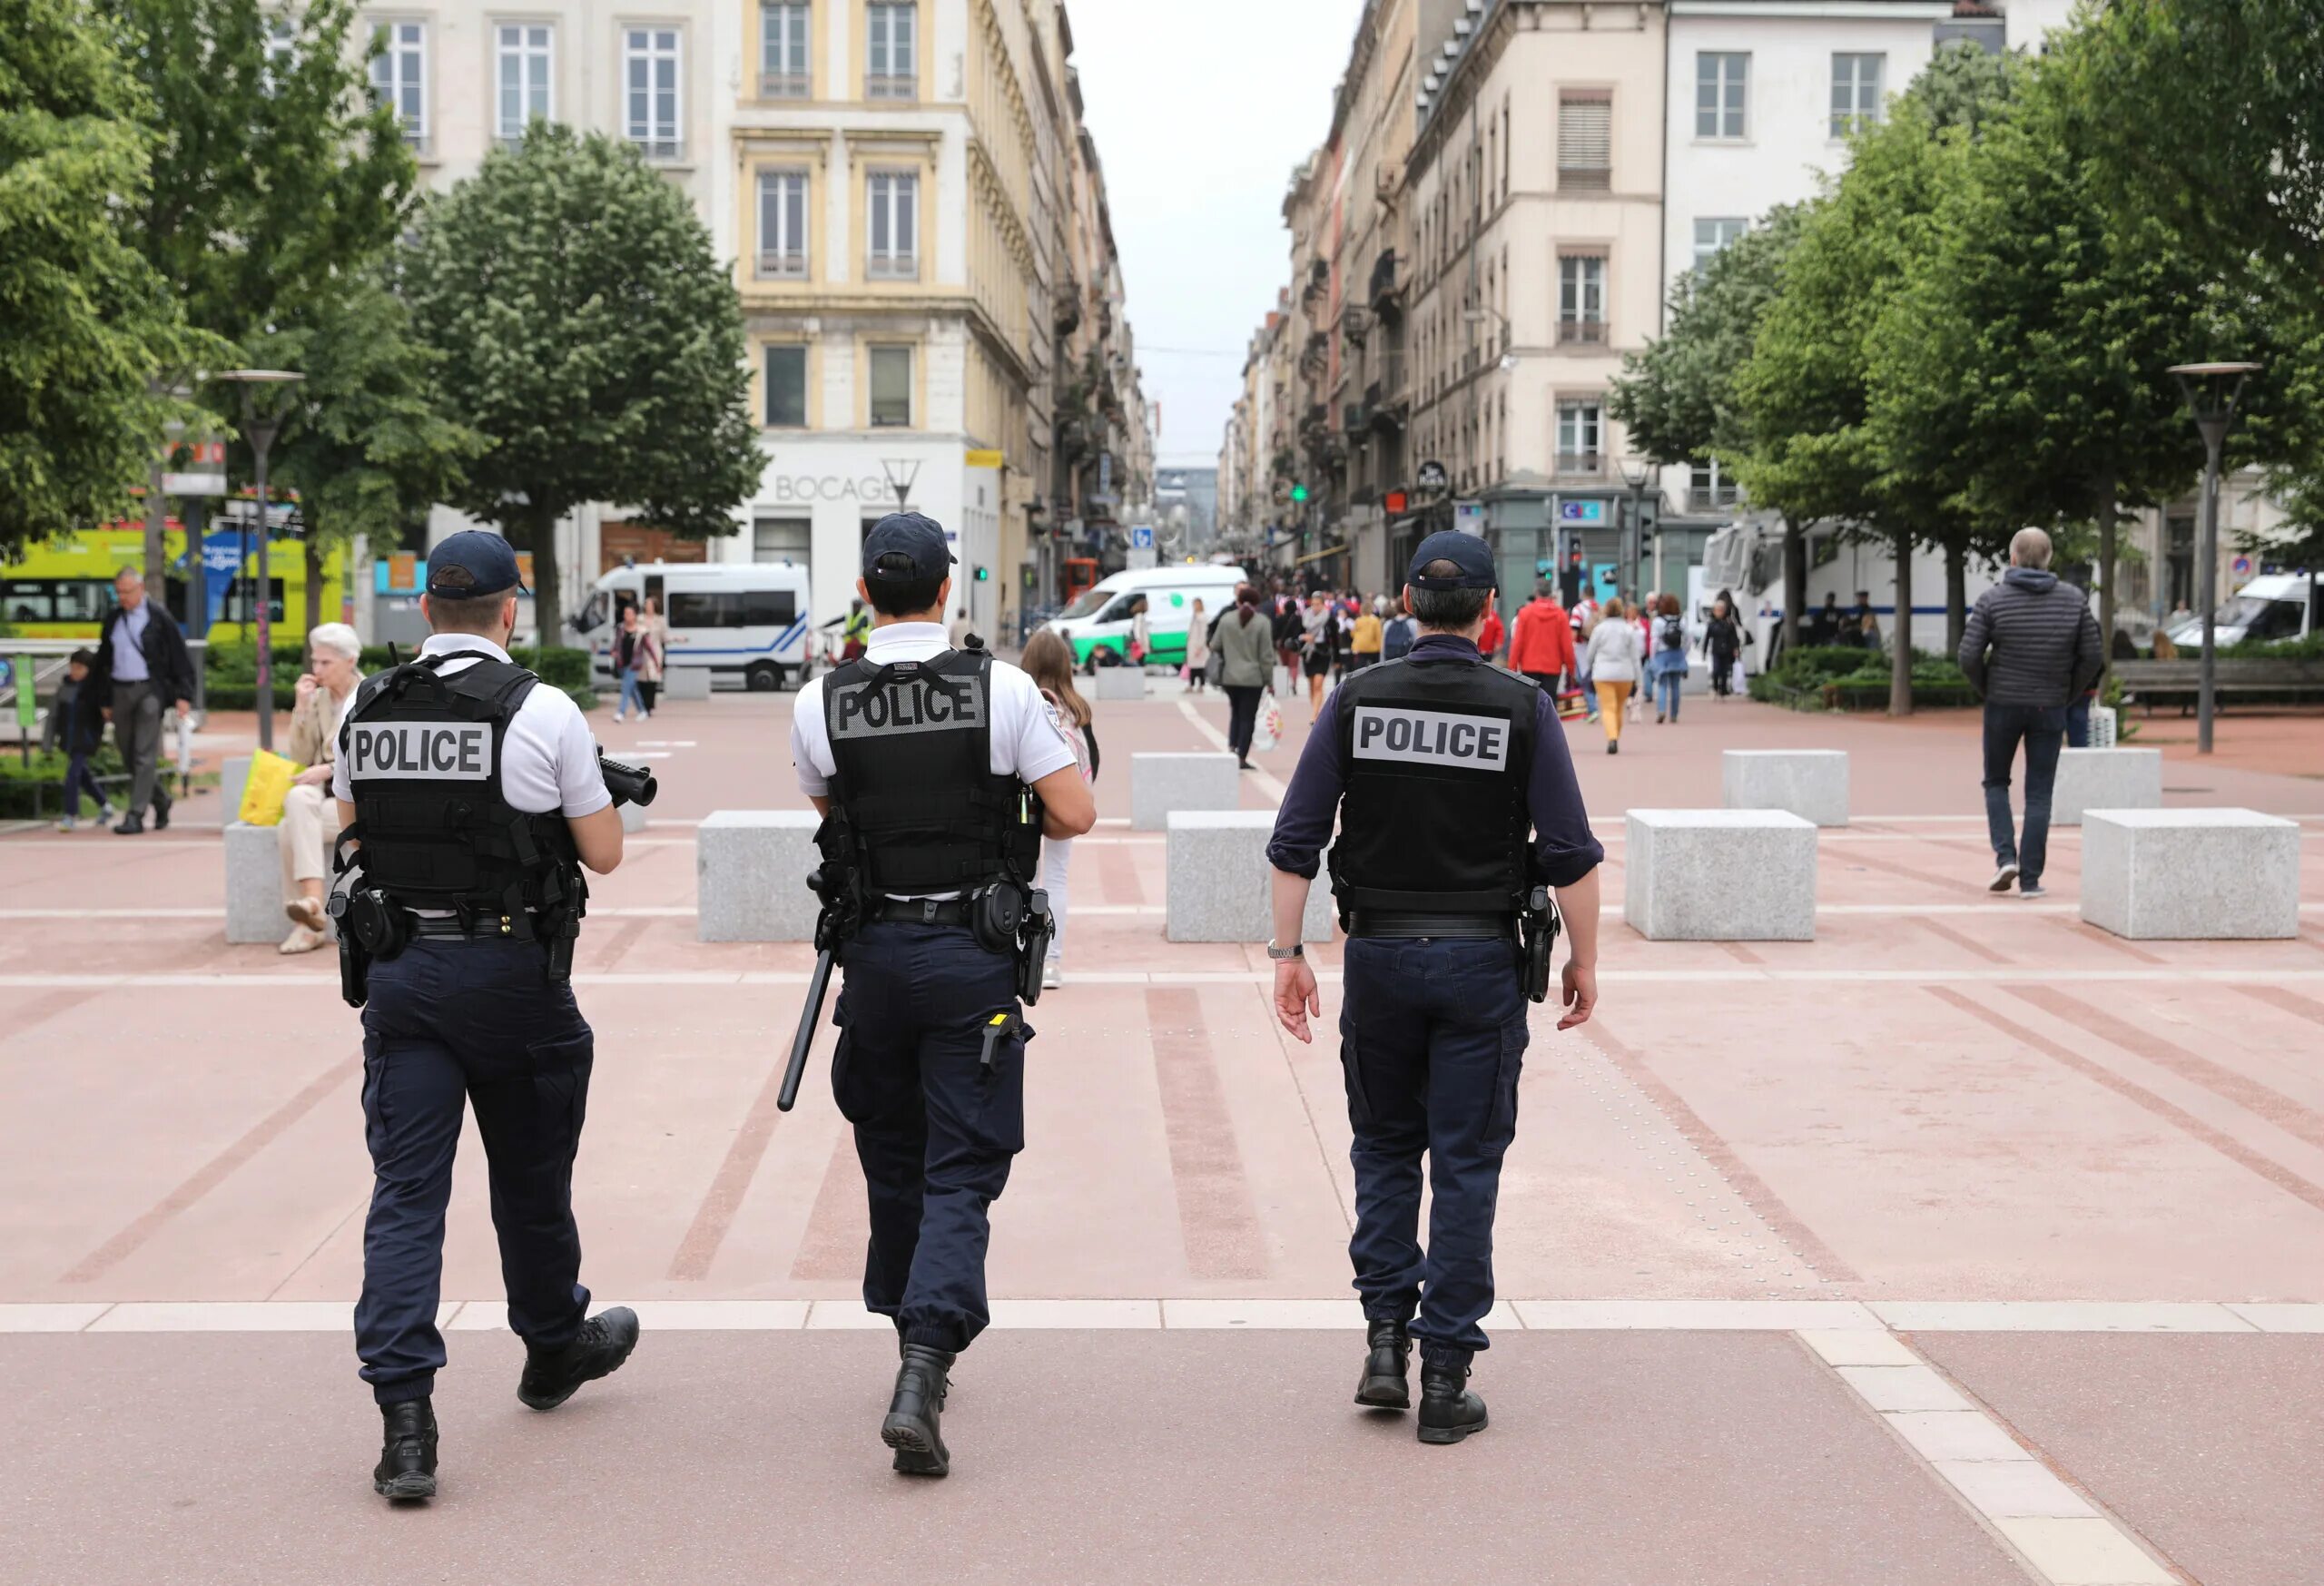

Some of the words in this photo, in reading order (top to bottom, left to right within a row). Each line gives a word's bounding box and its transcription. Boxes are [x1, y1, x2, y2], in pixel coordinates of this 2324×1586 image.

[775, 475, 895, 501] BOCAGE
[839, 682, 976, 731] POLICE
[355, 729, 482, 772] POLICE
[1360, 715, 1501, 761] POLICE
